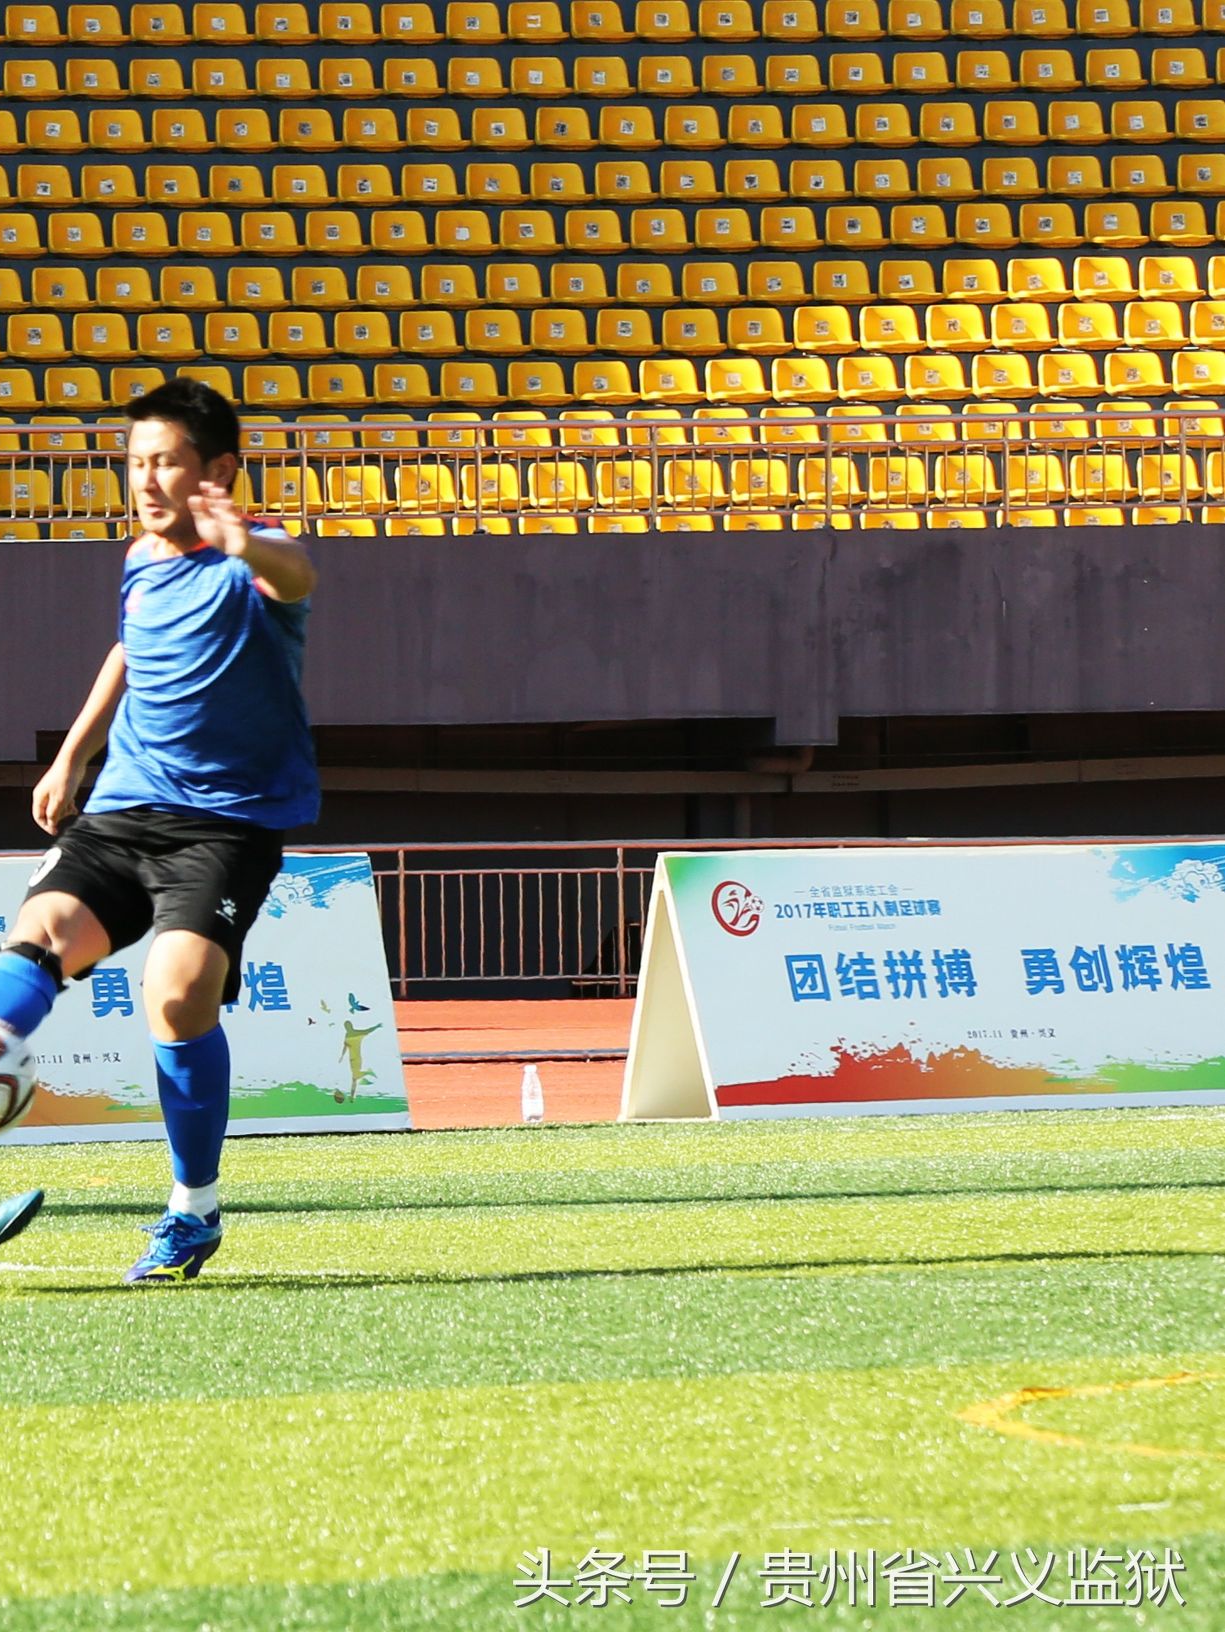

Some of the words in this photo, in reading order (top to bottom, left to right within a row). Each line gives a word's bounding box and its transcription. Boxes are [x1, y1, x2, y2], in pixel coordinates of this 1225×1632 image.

[774, 899, 942, 919] 2017年职工五人制足球赛
[784, 948, 978, 1002] 团结拼搏
[1020, 942, 1211, 996] 勇创辉煌
